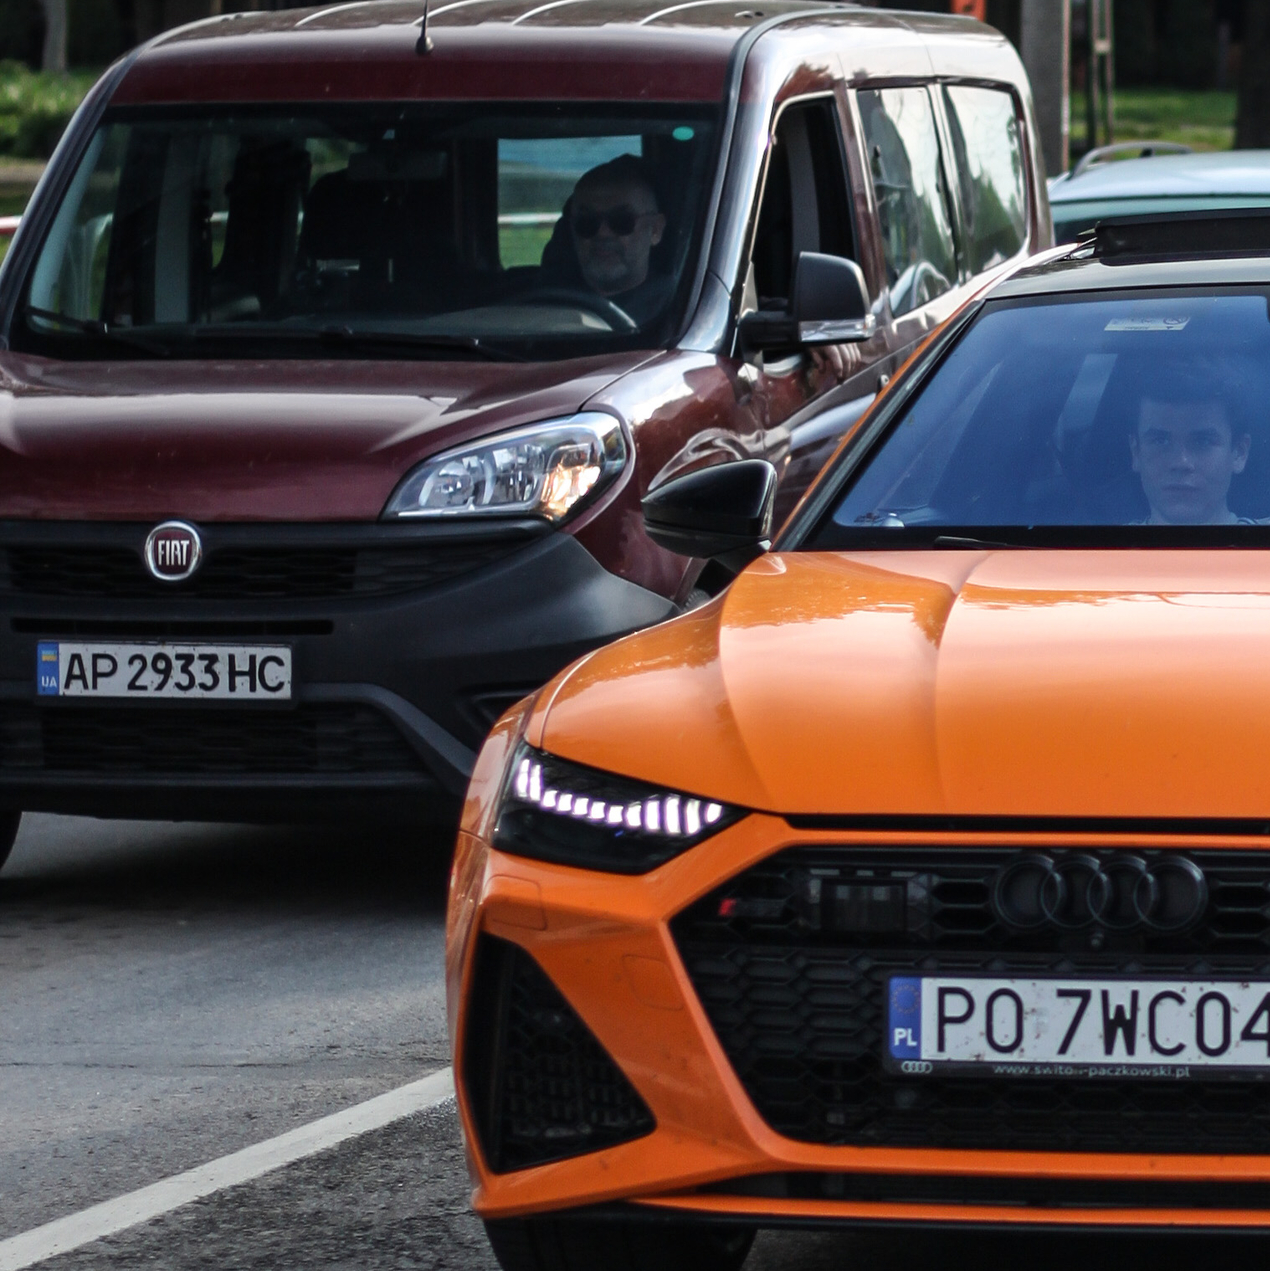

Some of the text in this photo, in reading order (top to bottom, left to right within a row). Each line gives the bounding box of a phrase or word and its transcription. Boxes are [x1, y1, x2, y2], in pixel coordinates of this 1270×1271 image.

[157, 539, 190, 566] FIAT
[41, 675, 58, 688] UA
[63, 652, 286, 693] AP 2933 HC
[936, 986, 1023, 1054] PO
[893, 1028, 918, 1048] PL
